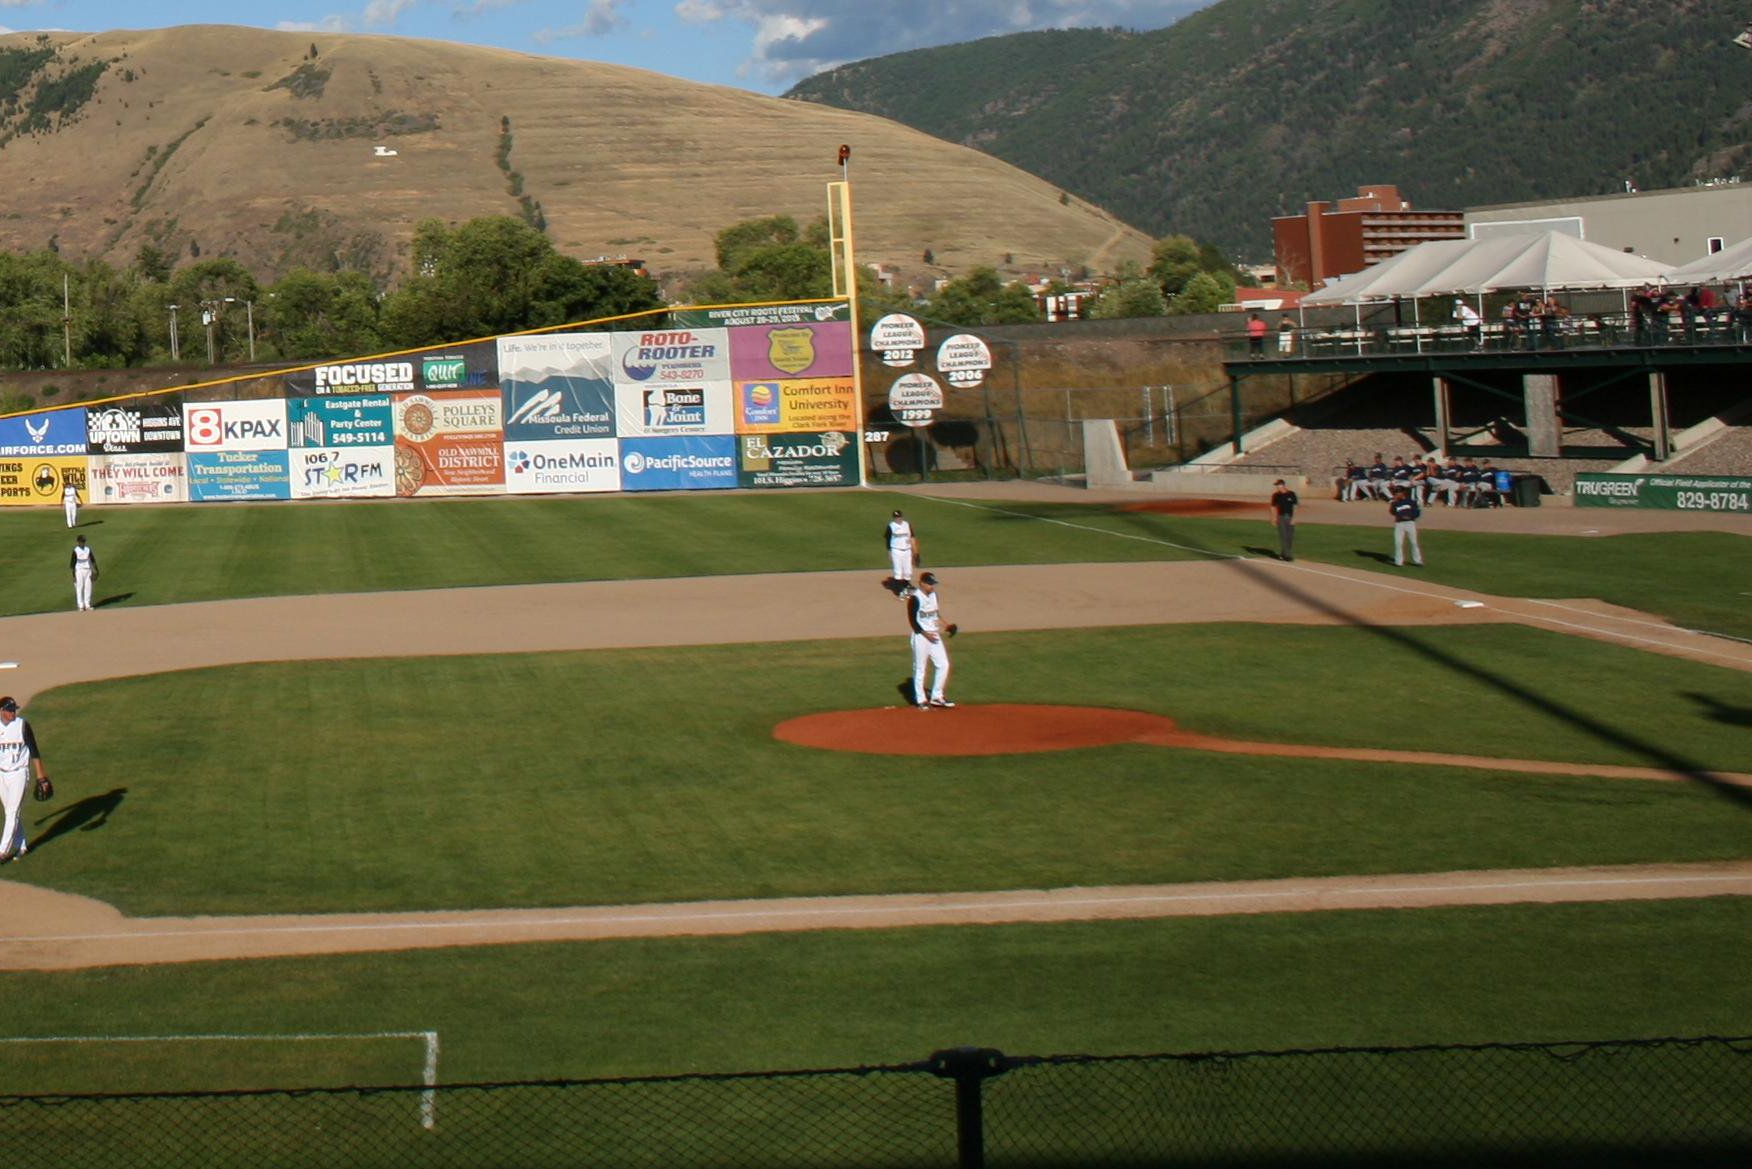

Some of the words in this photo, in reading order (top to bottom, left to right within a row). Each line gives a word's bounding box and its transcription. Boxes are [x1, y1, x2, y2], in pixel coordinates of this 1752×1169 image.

[709, 311, 732, 319] RIVER
[733, 310, 749, 318] CITY
[750, 308, 777, 317] ROOTS
[778, 306, 813, 316] FESTIVAL
[640, 332, 698, 346] ROTO-
[504, 343, 522, 352] Life.
[524, 344, 547, 352] We're
[638, 345, 715, 360] ROOTER
[883, 350, 914, 360] 2012
[941, 360, 989, 368] CHAMPIONS
[315, 362, 413, 386] FOCUSED
[428, 363, 464, 382] QUIT
[660, 369, 704, 380] 543-8270
[948, 370, 983, 381] 2006
[783, 385, 831, 397] Comfort
[835, 384, 854, 394] Inn
[325, 400, 361, 410] Eastgate
[362, 397, 389, 407] Rental
[666, 393, 701, 403] Bone
[443, 404, 495, 417] POLLEYS
[789, 400, 849, 410] University
[354, 409, 361, 418] &
[667, 410, 701, 422] Joint
[745, 407, 778, 416] Comfort
[902, 409, 932, 420] 1999
[330, 420, 353, 430] Party
[354, 418, 382, 428] Center
[443, 415, 496, 428] SQUARE
[528, 414, 570, 424] Missoula
[572, 412, 609, 422] Federal
[818, 415, 837, 423] along
[190, 410, 220, 443] 8
[224, 419, 282, 439] KPAX
[554, 425, 581, 434] Credit
[583, 424, 609, 433] Union
[89, 430, 141, 443] UPTOWN
[333, 432, 385, 443] 549-5114
[747, 437, 765, 448] EL
[865, 431, 890, 442] 287
[217, 451, 258, 462] Tucker
[438, 448, 457, 456] OLD
[458, 447, 499, 456] SAWMILL
[746, 444, 841, 459] CAZADOR
[439, 455, 500, 468] DISTRICT
[533, 453, 614, 469] OneMain
[646, 455, 732, 471] PacificSource
[92, 468, 120, 479] THEY
[123, 467, 150, 478] WILL
[153, 466, 184, 477] COME
[194, 462, 282, 476] Transportation
[360, 462, 382, 478] FM
[62, 473, 86, 482] WILD
[535, 472, 589, 483] Financial
[1675, 479, 1692, 487] Field
[1693, 480, 1729, 488] Applicator
[1576, 481, 1637, 496] TRUGREEN
[1676, 492, 1749, 510] 829-8784
